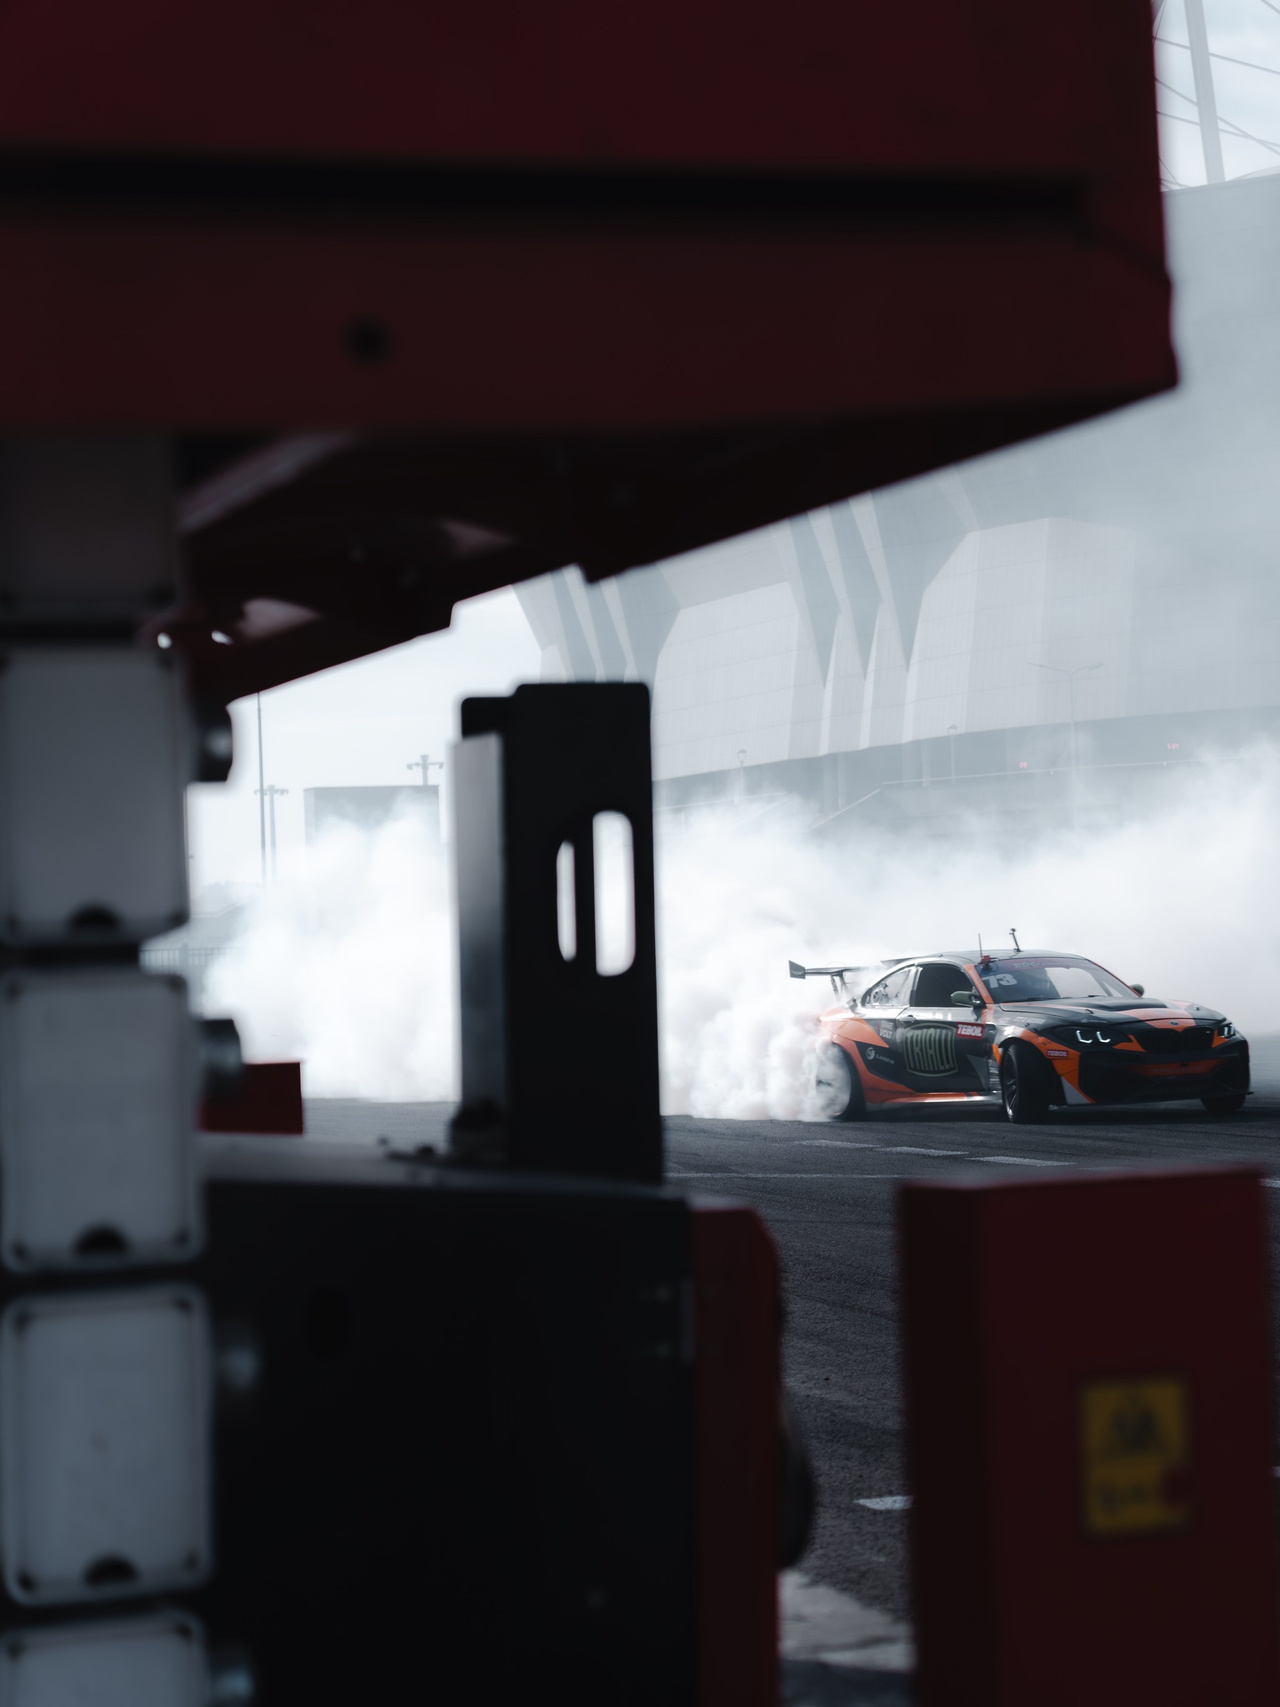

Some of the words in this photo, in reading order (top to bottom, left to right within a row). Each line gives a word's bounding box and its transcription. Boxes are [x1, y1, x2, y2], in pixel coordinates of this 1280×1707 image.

[982, 973, 1018, 989] 73
[957, 1024, 983, 1037] TEBOIL
[905, 1028, 955, 1071] TRIALLI
